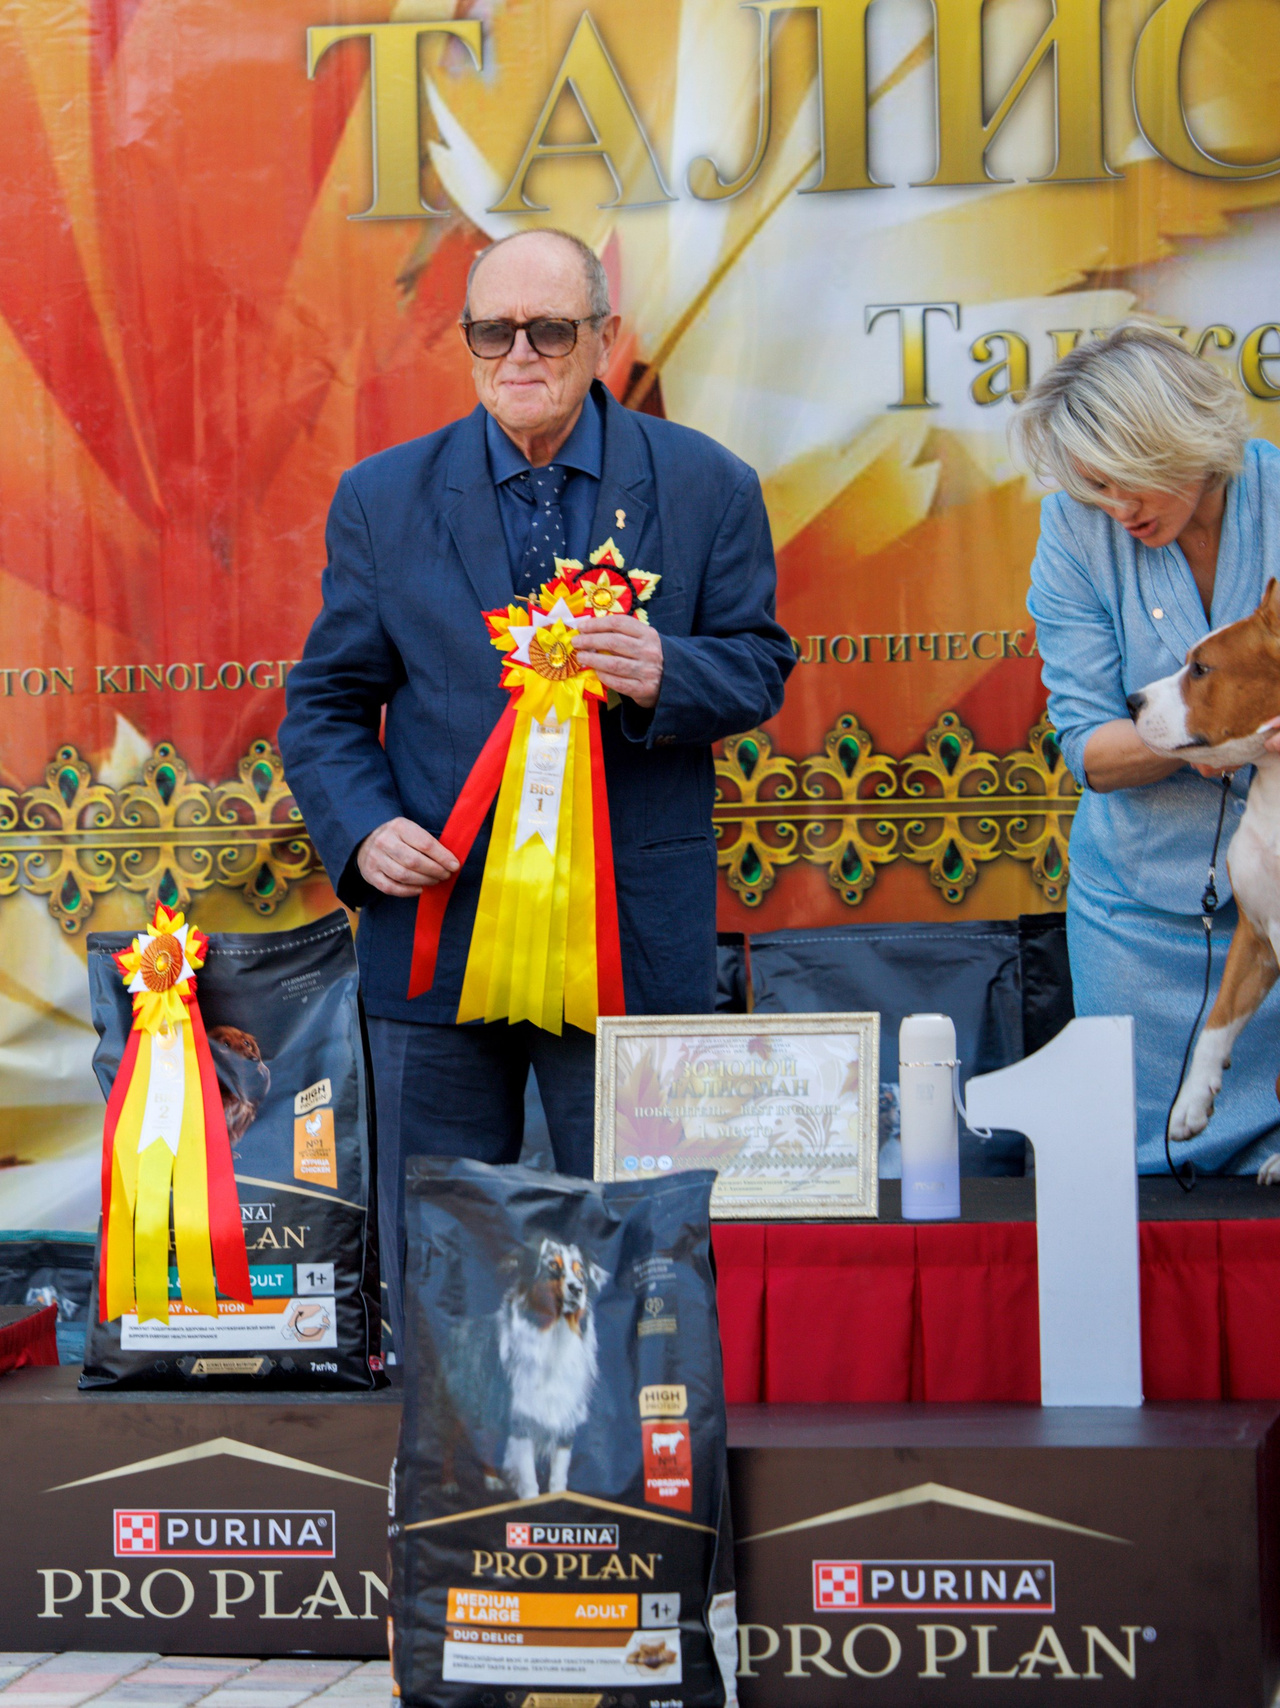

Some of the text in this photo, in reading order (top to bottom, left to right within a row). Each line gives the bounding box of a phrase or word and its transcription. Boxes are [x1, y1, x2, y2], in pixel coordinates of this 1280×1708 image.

[96, 658, 301, 693] KINOLOGI
[529, 783, 556, 796] BIG
[535, 798, 544, 812] 1
[682, 1056, 798, 1078] ЗОЛОТОЙ
[301, 1084, 326, 1104] HIGH
[965, 1015, 1144, 1407] 1
[306, 1271, 328, 1287] 1+
[645, 1390, 680, 1402] HIGH
[471, 1549, 548, 1579] PRO
[36, 1568, 195, 1618] PRO
[455, 1592, 519, 1608] MEDIUM
[455, 1608, 520, 1623] & LARGE
[575, 1602, 672, 1619] ADULT 1+
[453, 1629, 524, 1643] DUO DELICE
[736, 1623, 902, 1678] PRO
